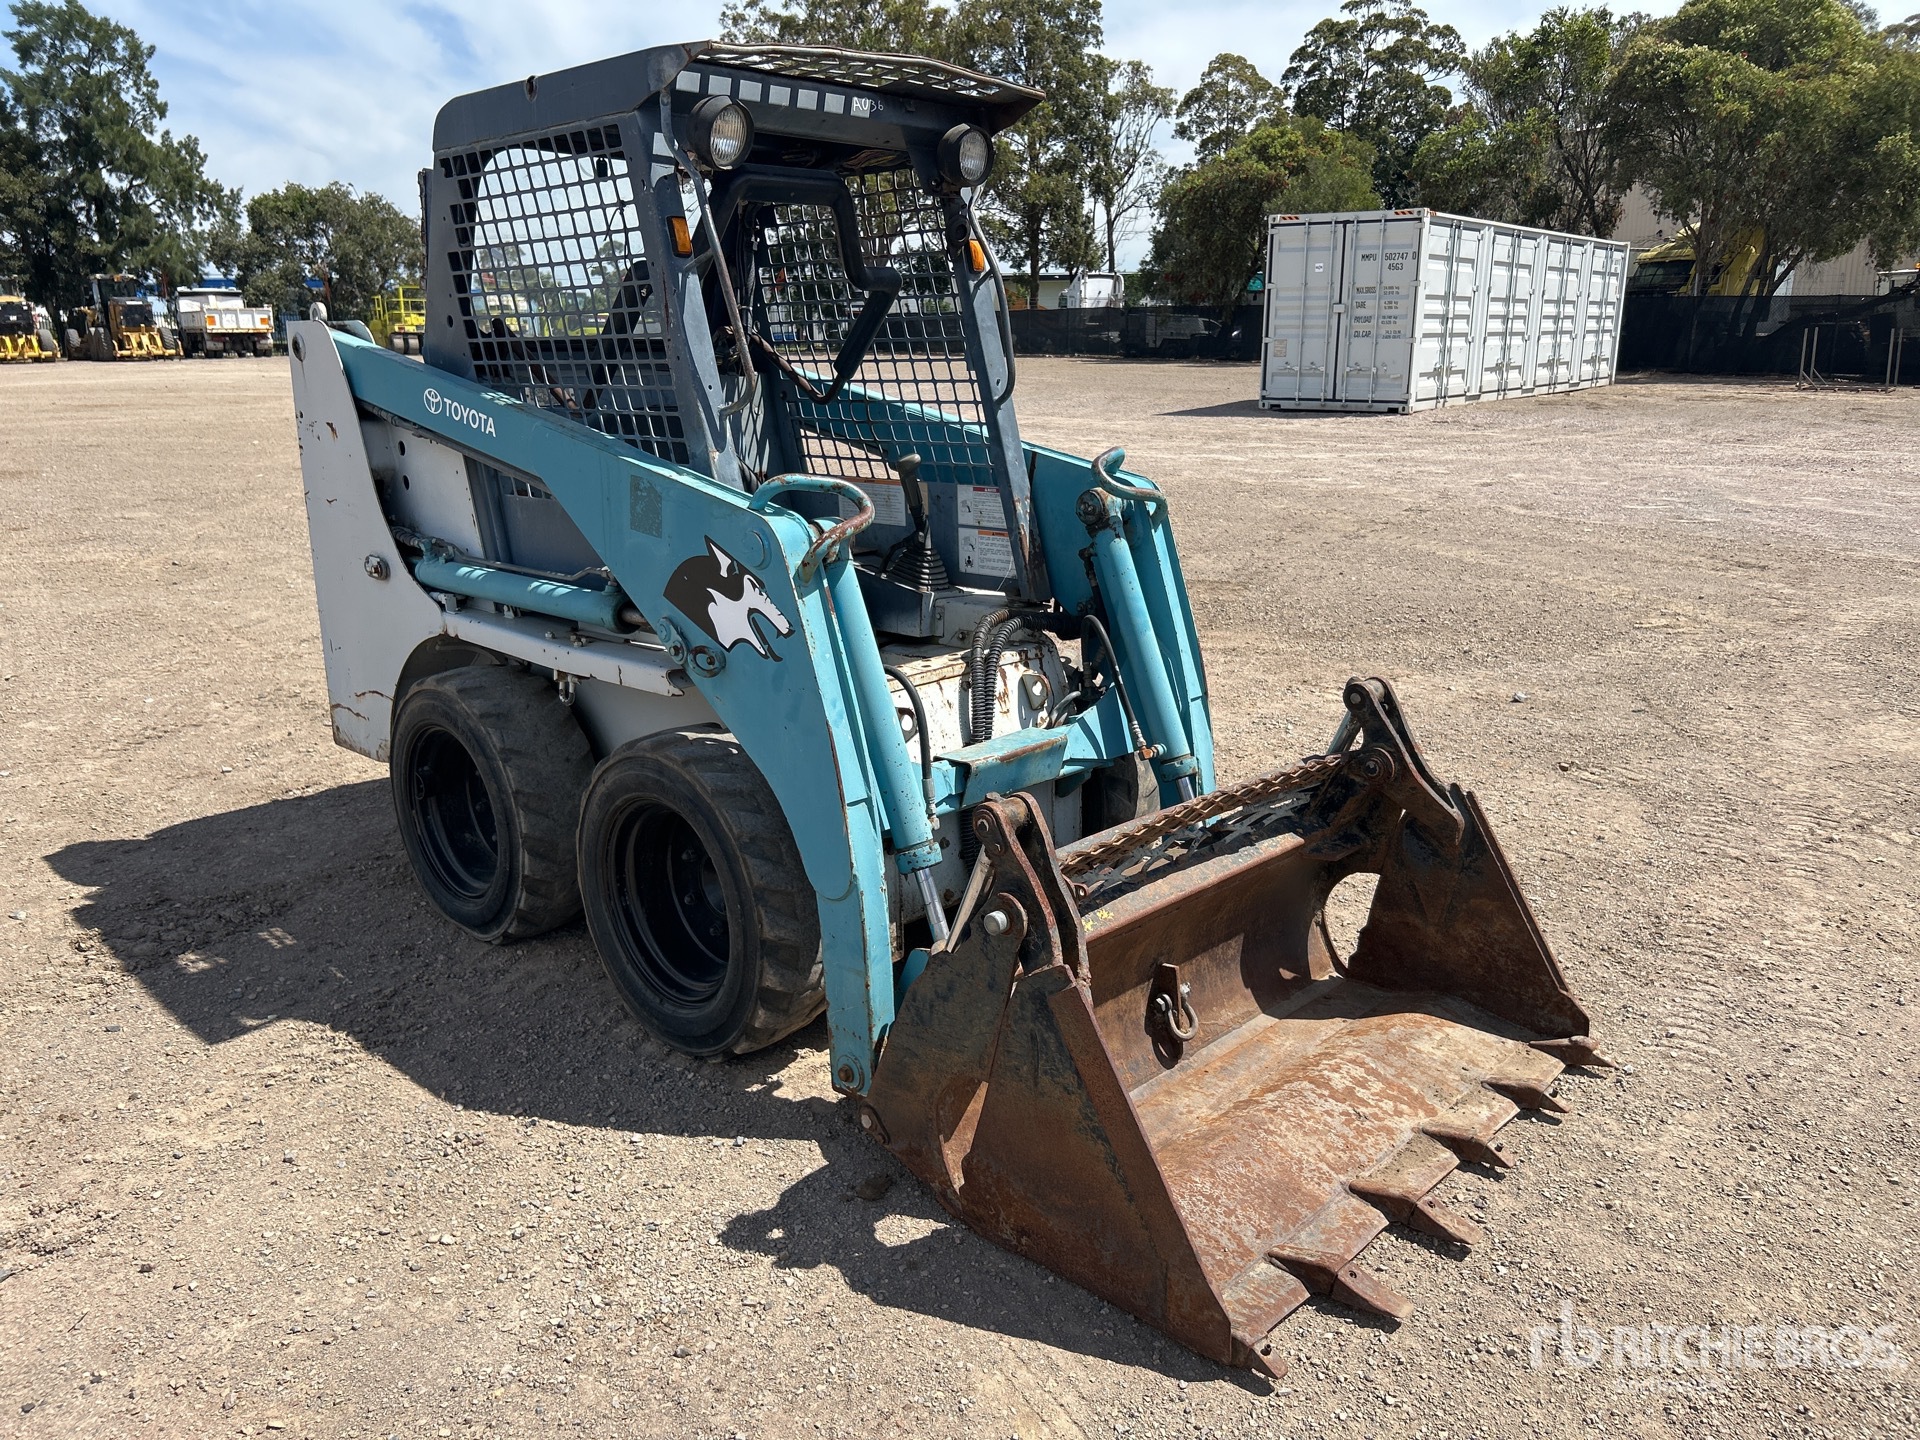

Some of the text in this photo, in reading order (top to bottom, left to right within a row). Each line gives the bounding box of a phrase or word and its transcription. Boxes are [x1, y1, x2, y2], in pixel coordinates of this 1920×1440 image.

[1361, 254, 1377, 262] MMPU
[1384, 252, 1408, 261] 502747
[443, 398, 496, 437] TOYOTA
